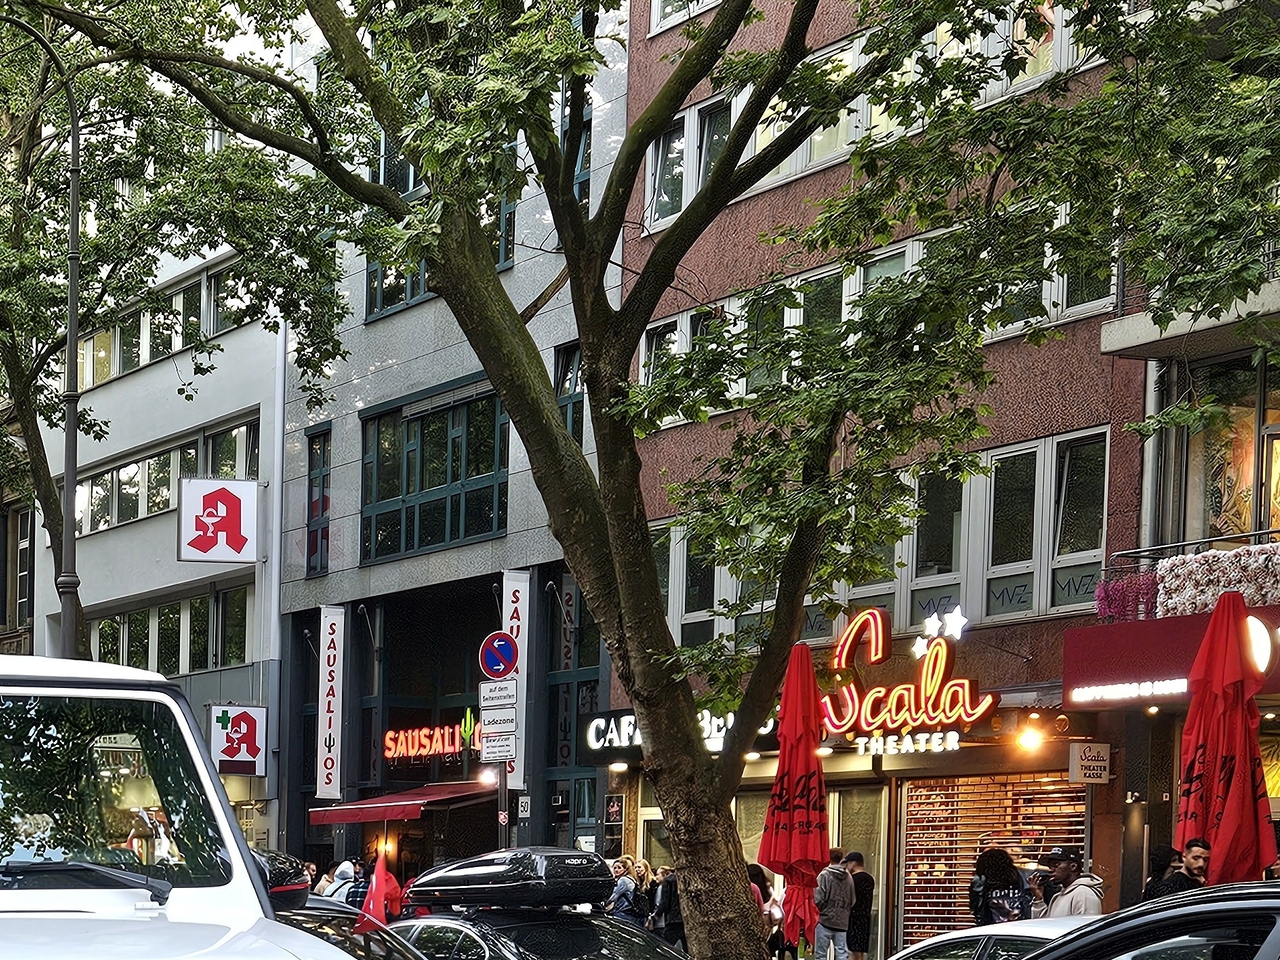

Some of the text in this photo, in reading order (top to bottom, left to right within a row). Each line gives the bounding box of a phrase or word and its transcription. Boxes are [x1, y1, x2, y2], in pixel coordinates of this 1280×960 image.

[991, 583, 1029, 607] MVZ
[821, 607, 996, 734] Scala
[483, 717, 515, 726] Ladezone
[855, 730, 960, 756] THEATER
[1080, 746, 1107, 762] Scala
[520, 801, 529, 814] 50
